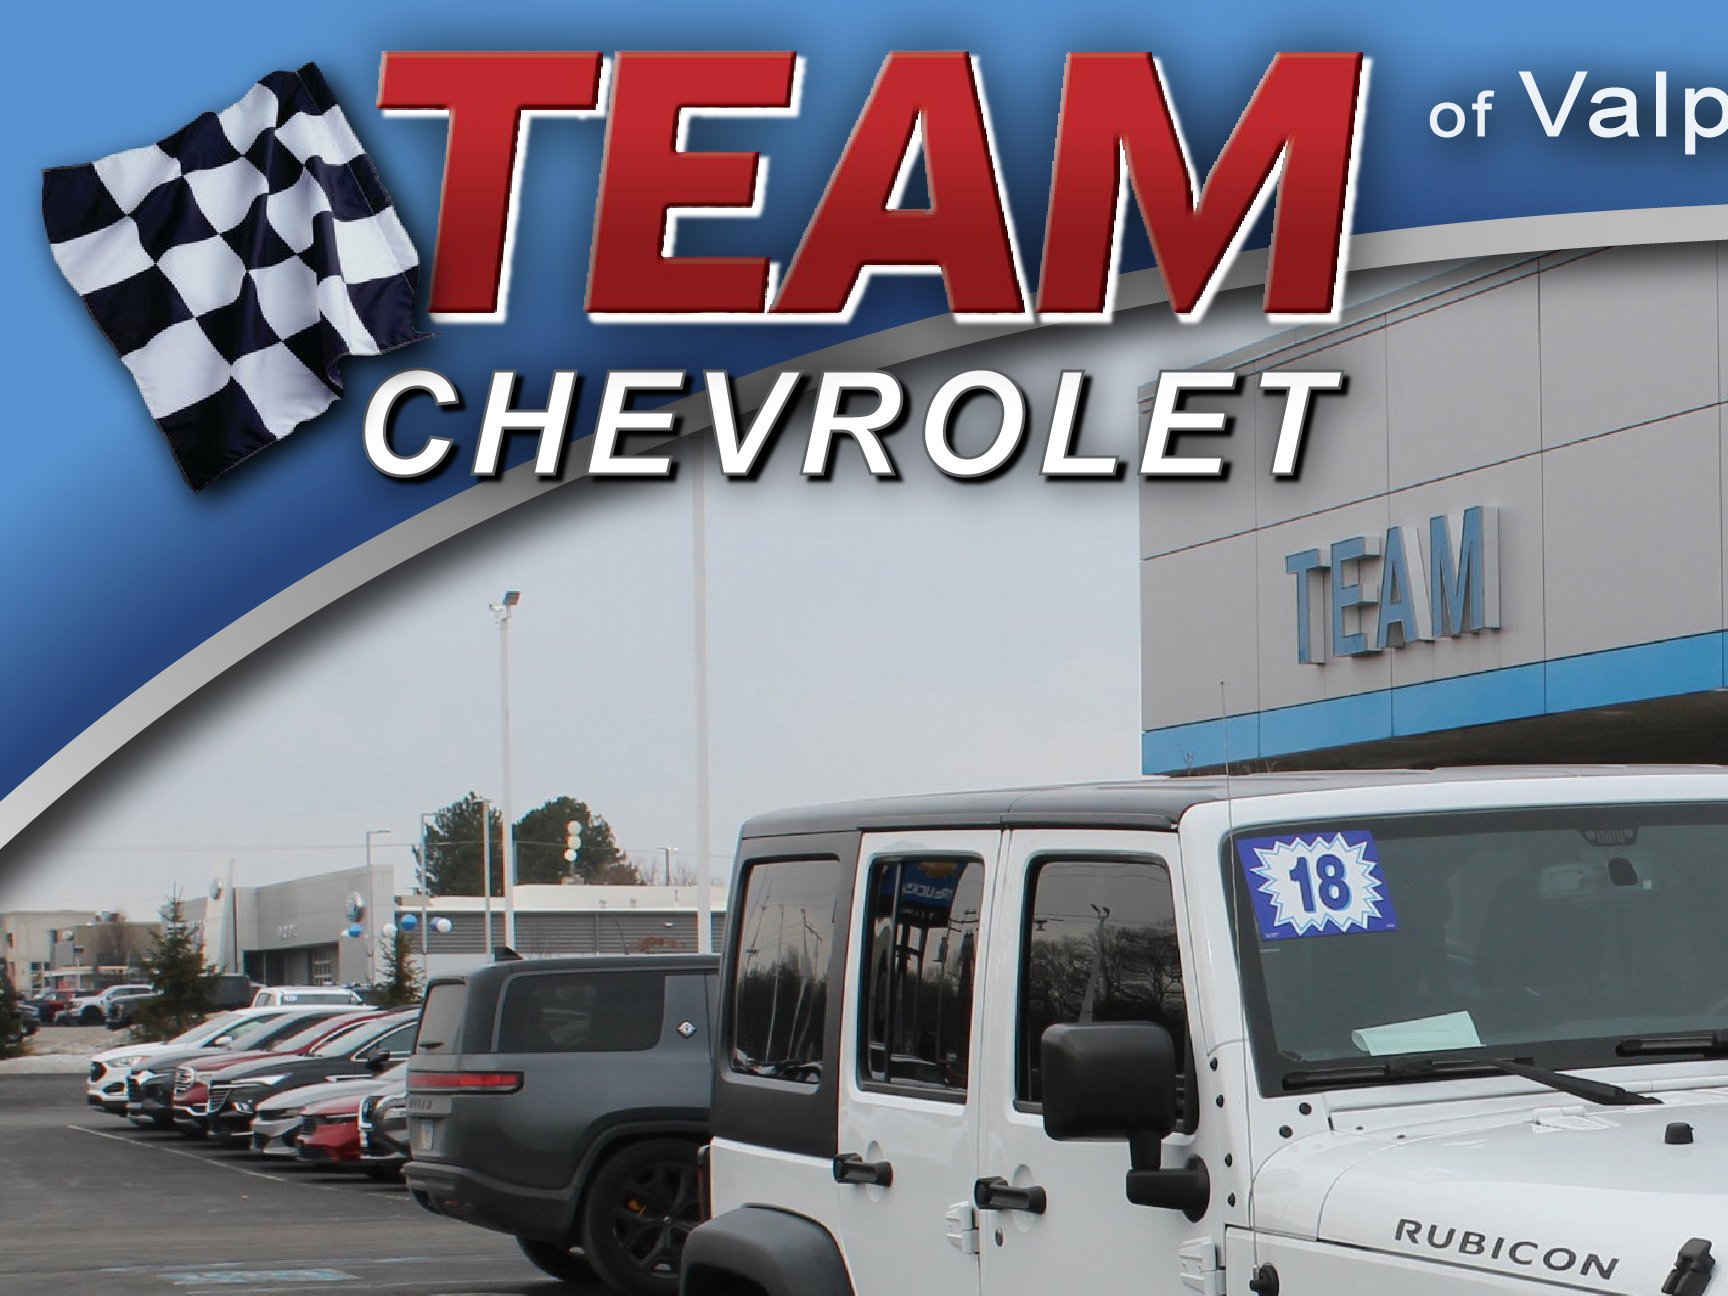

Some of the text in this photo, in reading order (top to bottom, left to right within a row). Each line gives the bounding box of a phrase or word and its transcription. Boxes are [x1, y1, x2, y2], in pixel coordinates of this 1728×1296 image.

[1285, 505, 1501, 665] TEAM
[1289, 853, 1352, 914] 18
[1395, 1218, 1619, 1280] RUBICON
